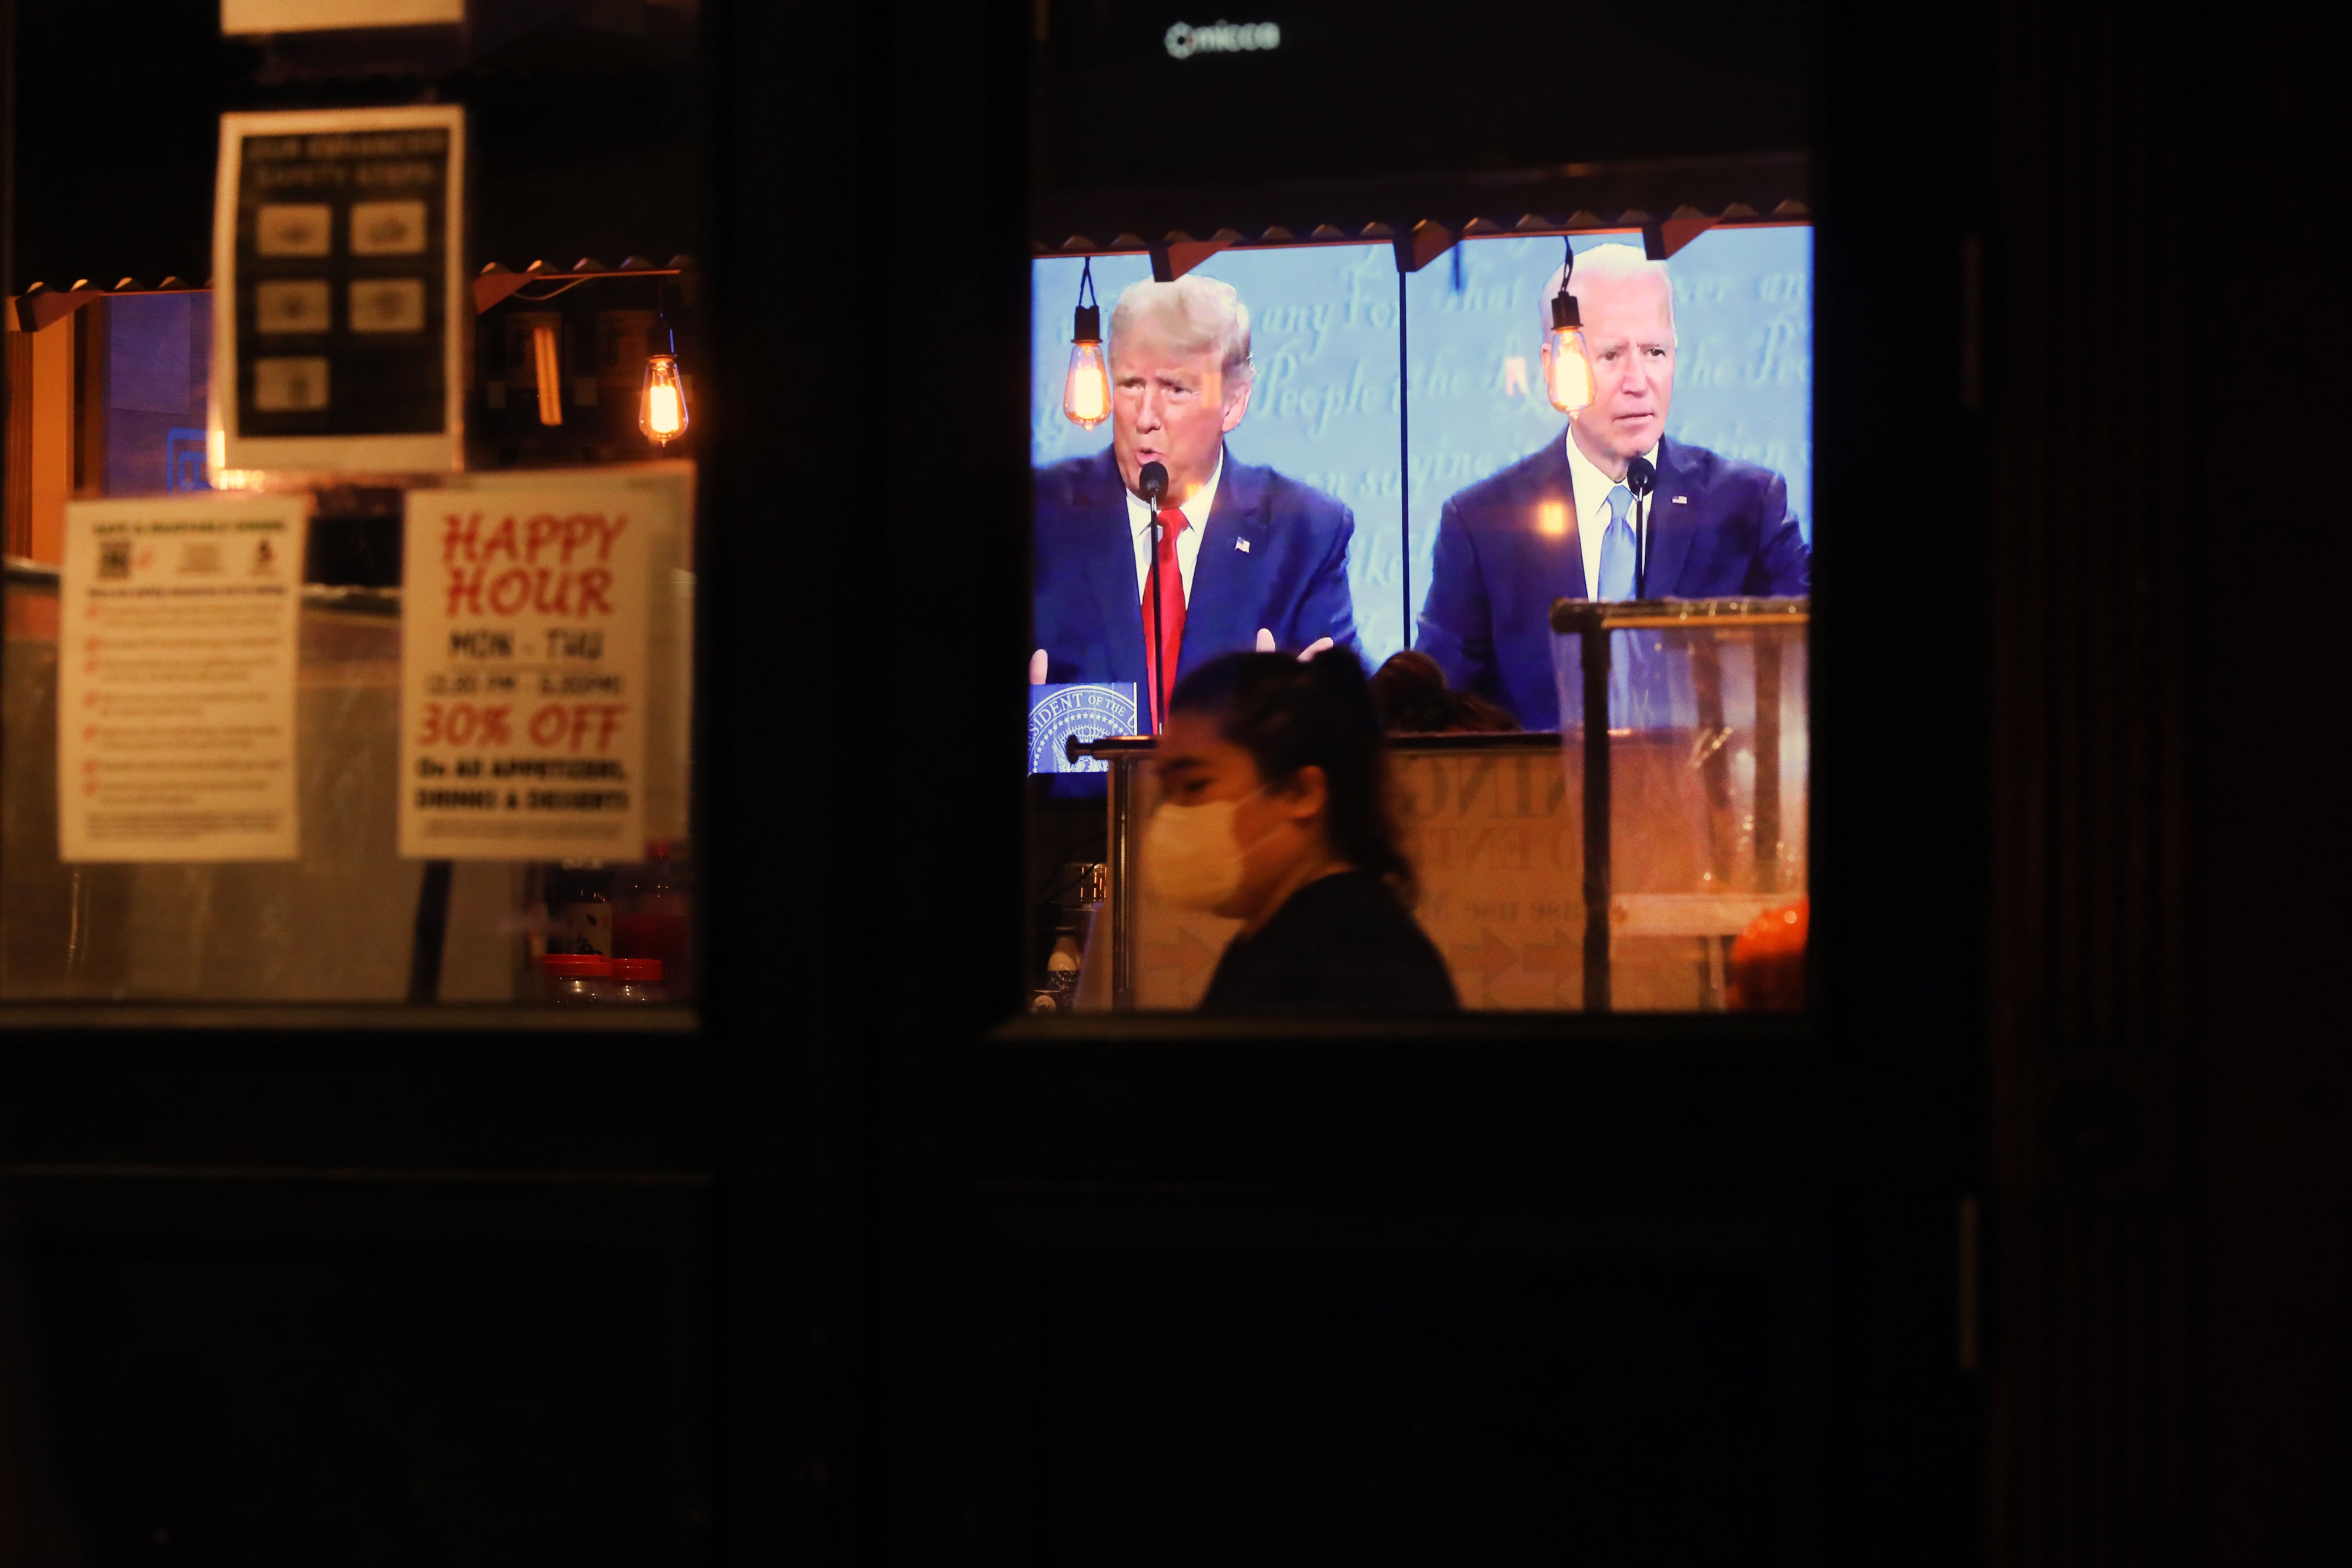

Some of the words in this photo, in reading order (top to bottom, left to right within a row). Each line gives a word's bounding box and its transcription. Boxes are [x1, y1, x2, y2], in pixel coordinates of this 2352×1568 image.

[442, 511, 629, 564] HAPPY
[445, 566, 615, 618] HOUR
[448, 628, 513, 659] MON
[547, 627, 604, 660] THU
[417, 703, 514, 747] 30%
[529, 703, 628, 753] OFF
[1088, 695, 1103, 707] OF
[1105, 698, 1127, 717] THE
